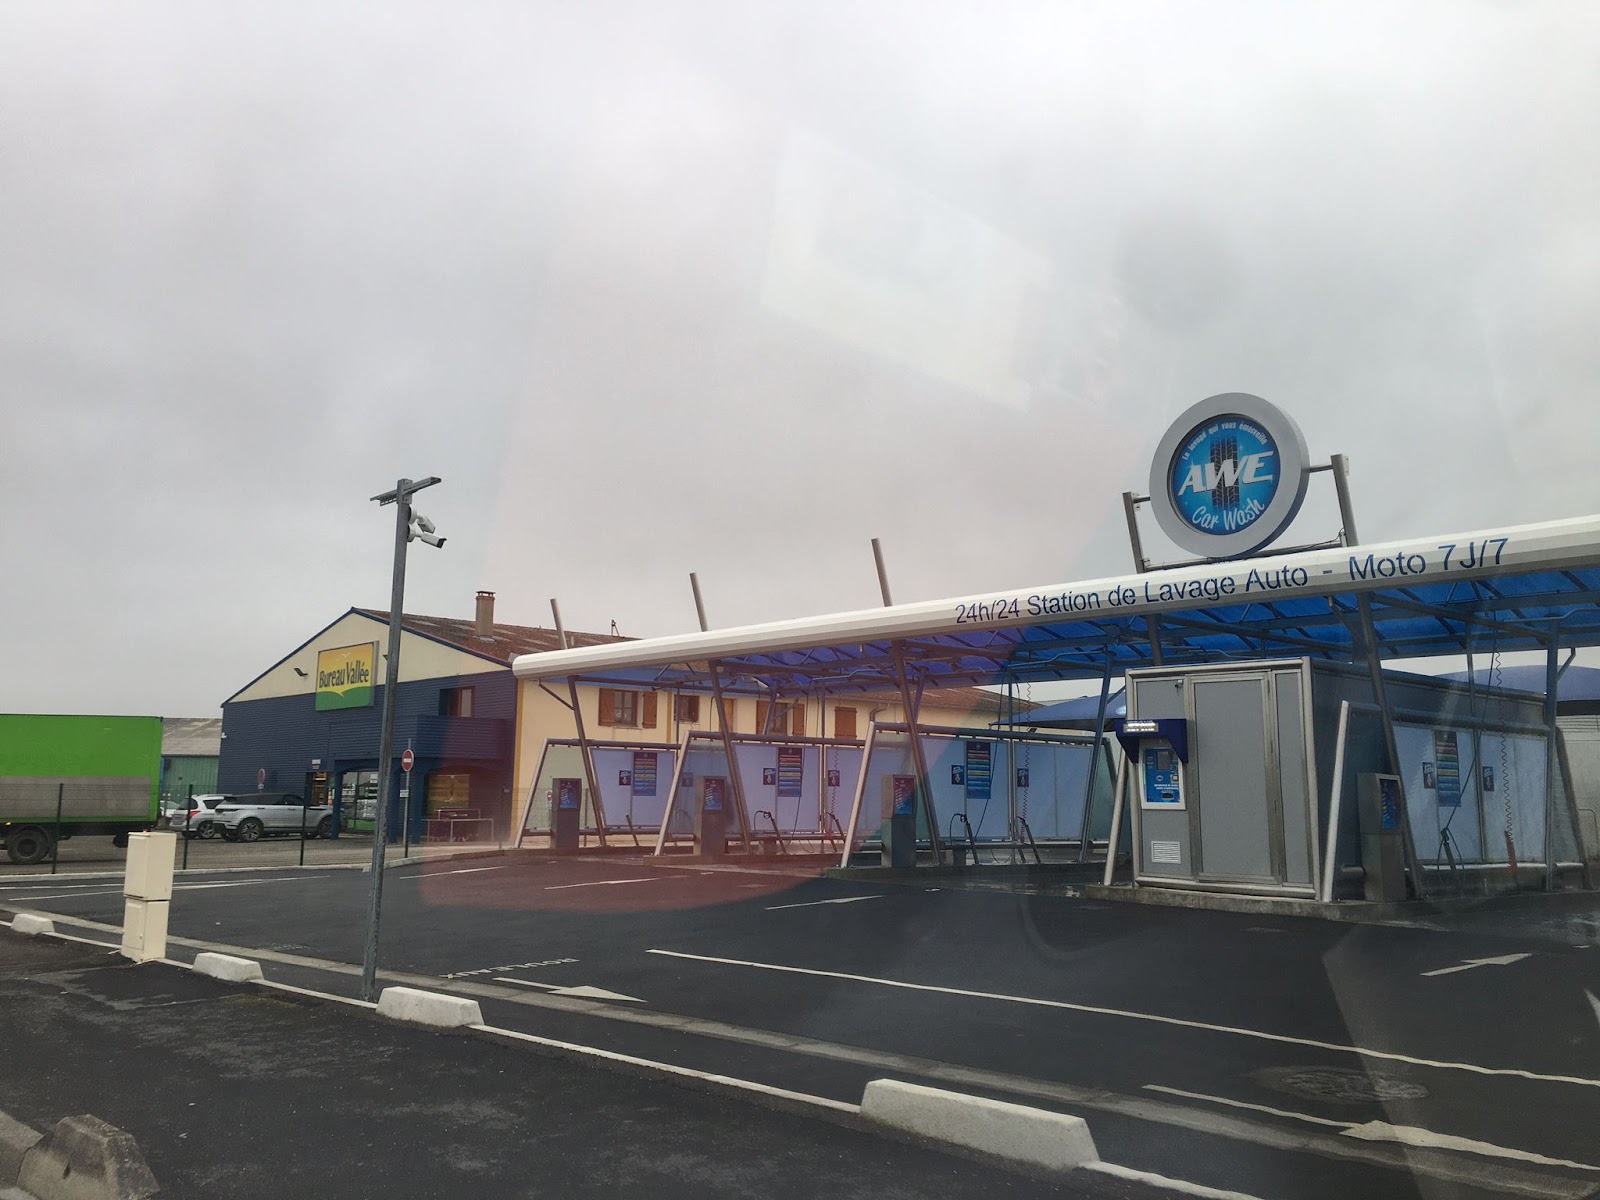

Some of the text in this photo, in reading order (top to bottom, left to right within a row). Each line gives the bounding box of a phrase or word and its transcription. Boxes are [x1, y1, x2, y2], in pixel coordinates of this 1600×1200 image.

[1208, 424, 1219, 435] qui
[1221, 422, 1237, 430] vous
[1178, 451, 1274, 496] AWE
[1192, 498, 1265, 531] Car Wash
[955, 598, 1020, 624] 24h/24
[1028, 590, 1100, 616] Station
[1107, 584, 1136, 607] de
[1145, 576, 1236, 603] Lavage
[1245, 564, 1308, 592] Auto
[1350, 552, 1426, 581] Moto
[320, 660, 369, 688] Bureau Vallée
